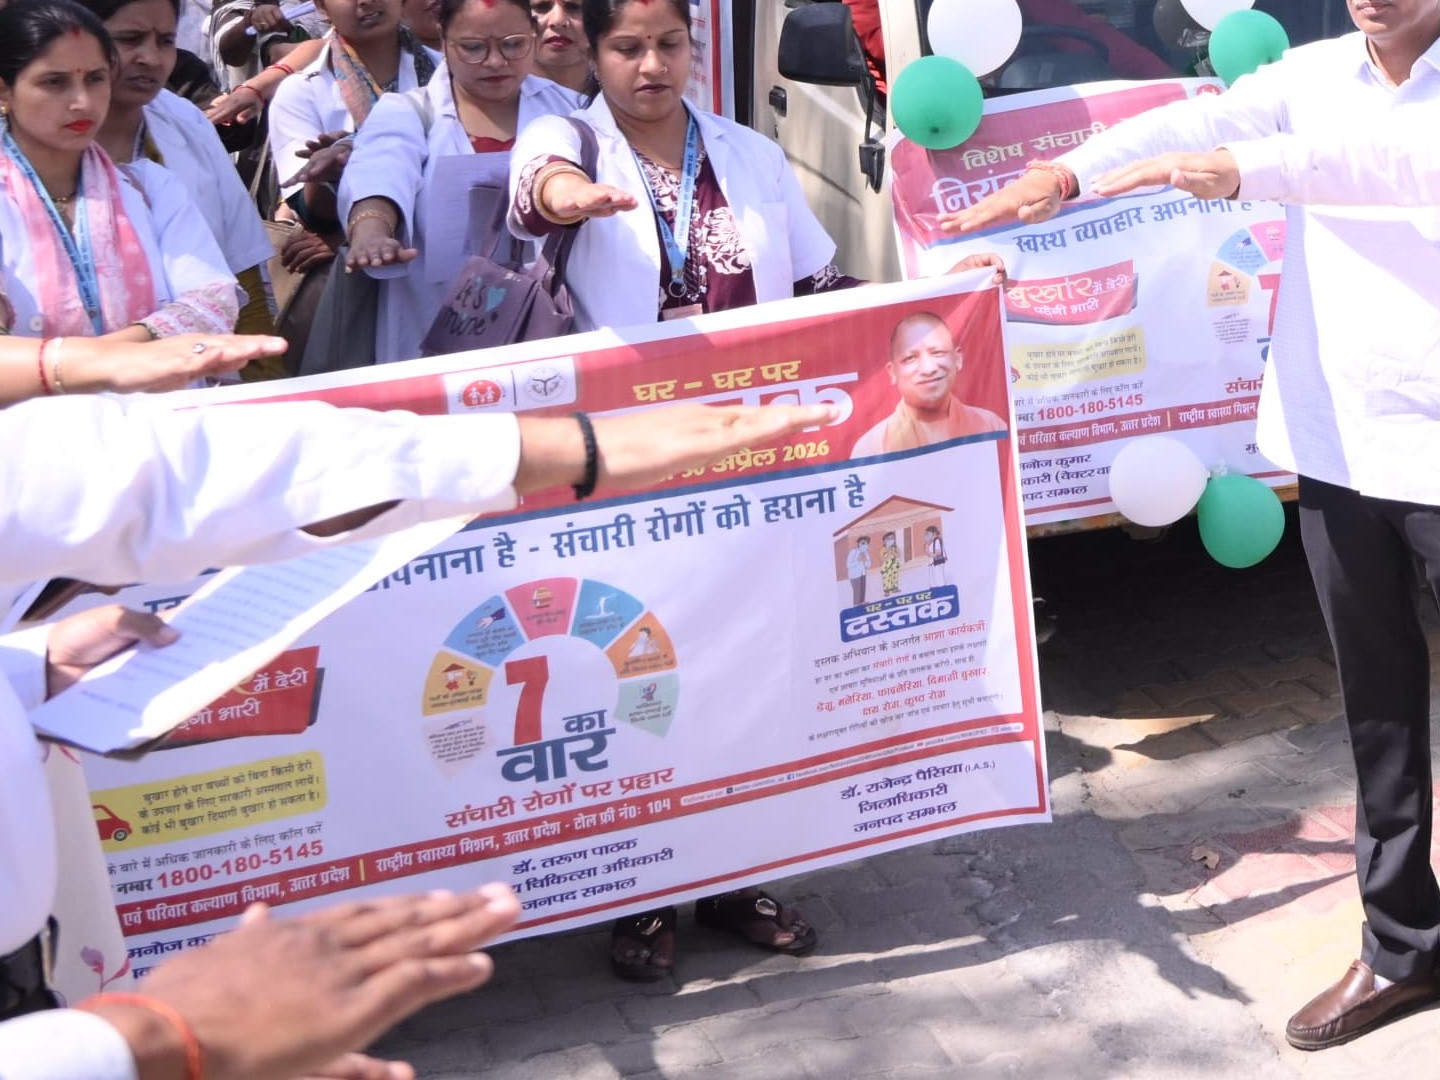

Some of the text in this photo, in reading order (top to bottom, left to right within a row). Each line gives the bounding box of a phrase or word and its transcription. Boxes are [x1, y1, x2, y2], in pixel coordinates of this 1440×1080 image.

[960, 142, 1025, 171] विशेष
[1013, 206, 1144, 254] स्वस्थ व्यवहार
[1006, 276, 1093, 308] बुखार
[633, 360, 801, 402] घर घर पर
[1037, 393, 1144, 421] 1800-180-5145
[783, 441, 829, 463] 2026
[1055, 454, 1092, 469] कुमार
[1046, 485, 1088, 498] सम्भल
[493, 473, 866, 568] है संचारी रोगों को हराना है
[844, 594, 955, 636] दस्तक
[254, 667, 309, 692] में देरी
[218, 697, 261, 721] भारी
[505, 655, 549, 746] 7
[562, 709, 607, 733] का
[496, 727, 616, 784] वार
[444, 768, 676, 828] संचारी रोगों पर प्रहार
[840, 784, 862, 800] डॉ.
[865, 773, 912, 795] राजेन्द्र
[915, 762, 963, 781] पैसिया
[858, 782, 949, 814] जिलाधिकारी
[853, 800, 958, 833] जनपद सम्भल
[121, 907, 142, 927] एवं
[146, 904, 187, 923] परिवार
[191, 893, 238, 914] कल्याण
[242, 883, 285, 904] विभाग,
[321, 866, 350, 886] प्रदेश
[376, 852, 413, 873] राष्ट्रीय
[459, 836, 500, 855] मिशन,
[533, 821, 561, 840] प्रदेश
[646, 798, 672, 815] 104
[141, 854, 151, 869] में
[155, 850, 190, 865] अधिक
[193, 840, 236, 861] जानकारी
[241, 837, 252, 850] के
[254, 831, 276, 847] लिए
[279, 826, 303, 841] कॉल
[306, 820, 323, 835] करें
[512, 858, 537, 875] डॉ.
[591, 838, 639, 857] पाठक
[116, 839, 324, 895] नम्बर 1800-180-5145
[525, 848, 675, 893] चिकित्सा अधिकारी
[521, 890, 577, 912] जनपद
[581, 876, 639, 898] सम्भल
[127, 939, 183, 959] मनोज
